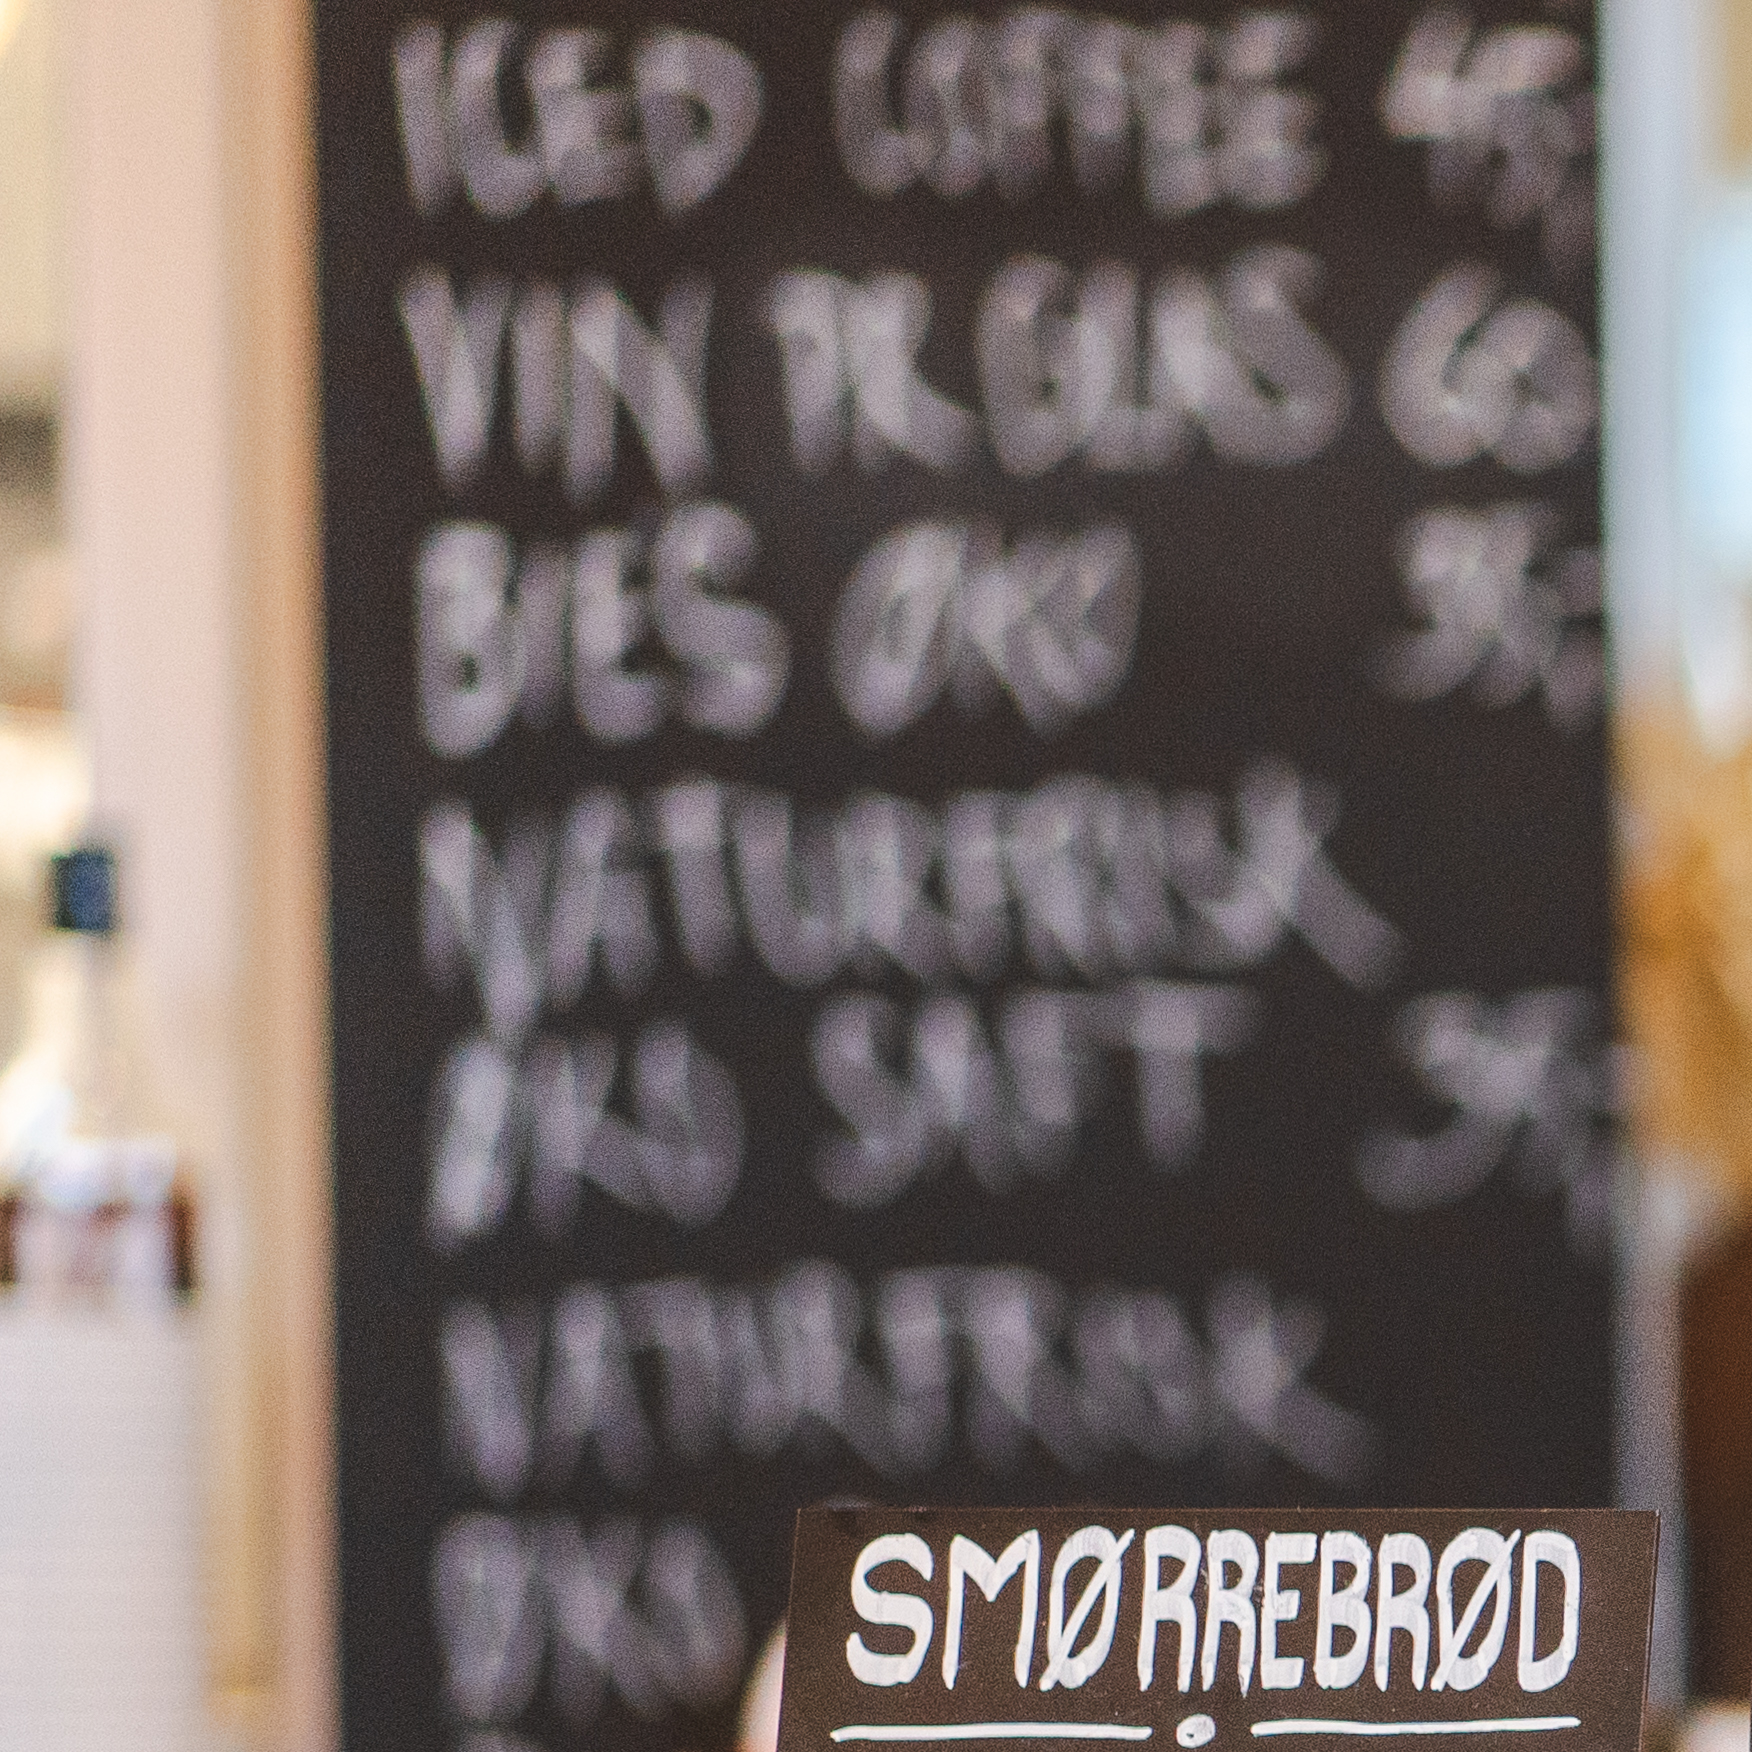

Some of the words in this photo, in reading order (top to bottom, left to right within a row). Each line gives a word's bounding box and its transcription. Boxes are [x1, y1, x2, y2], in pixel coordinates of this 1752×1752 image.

[392, 15, 765, 215] ICED
[400, 270, 715, 495] VIN
[844, 1524, 1582, 1696] SMØRREBRØD
